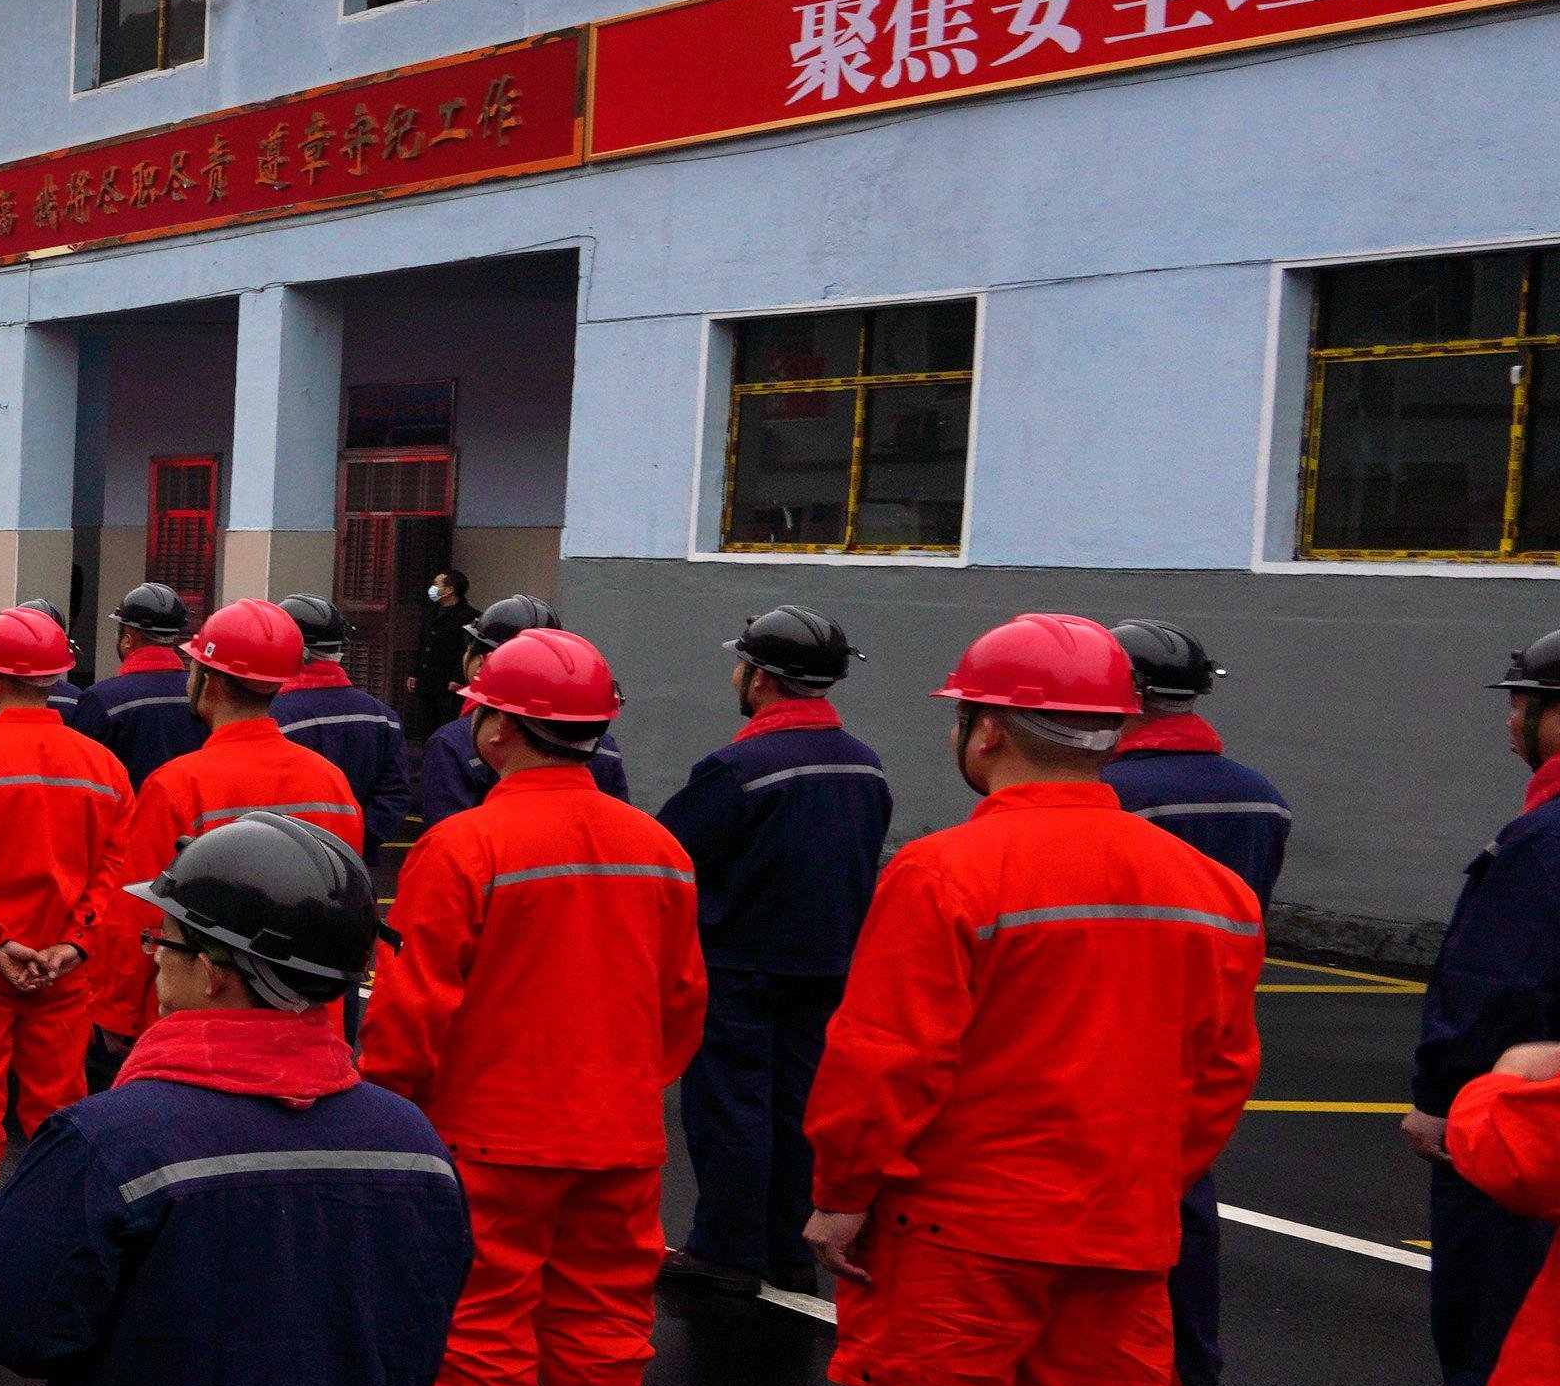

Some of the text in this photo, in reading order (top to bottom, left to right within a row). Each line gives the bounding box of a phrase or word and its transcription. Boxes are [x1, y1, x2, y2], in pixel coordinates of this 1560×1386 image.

[254, 75, 521, 191] 遵章守纪工作
